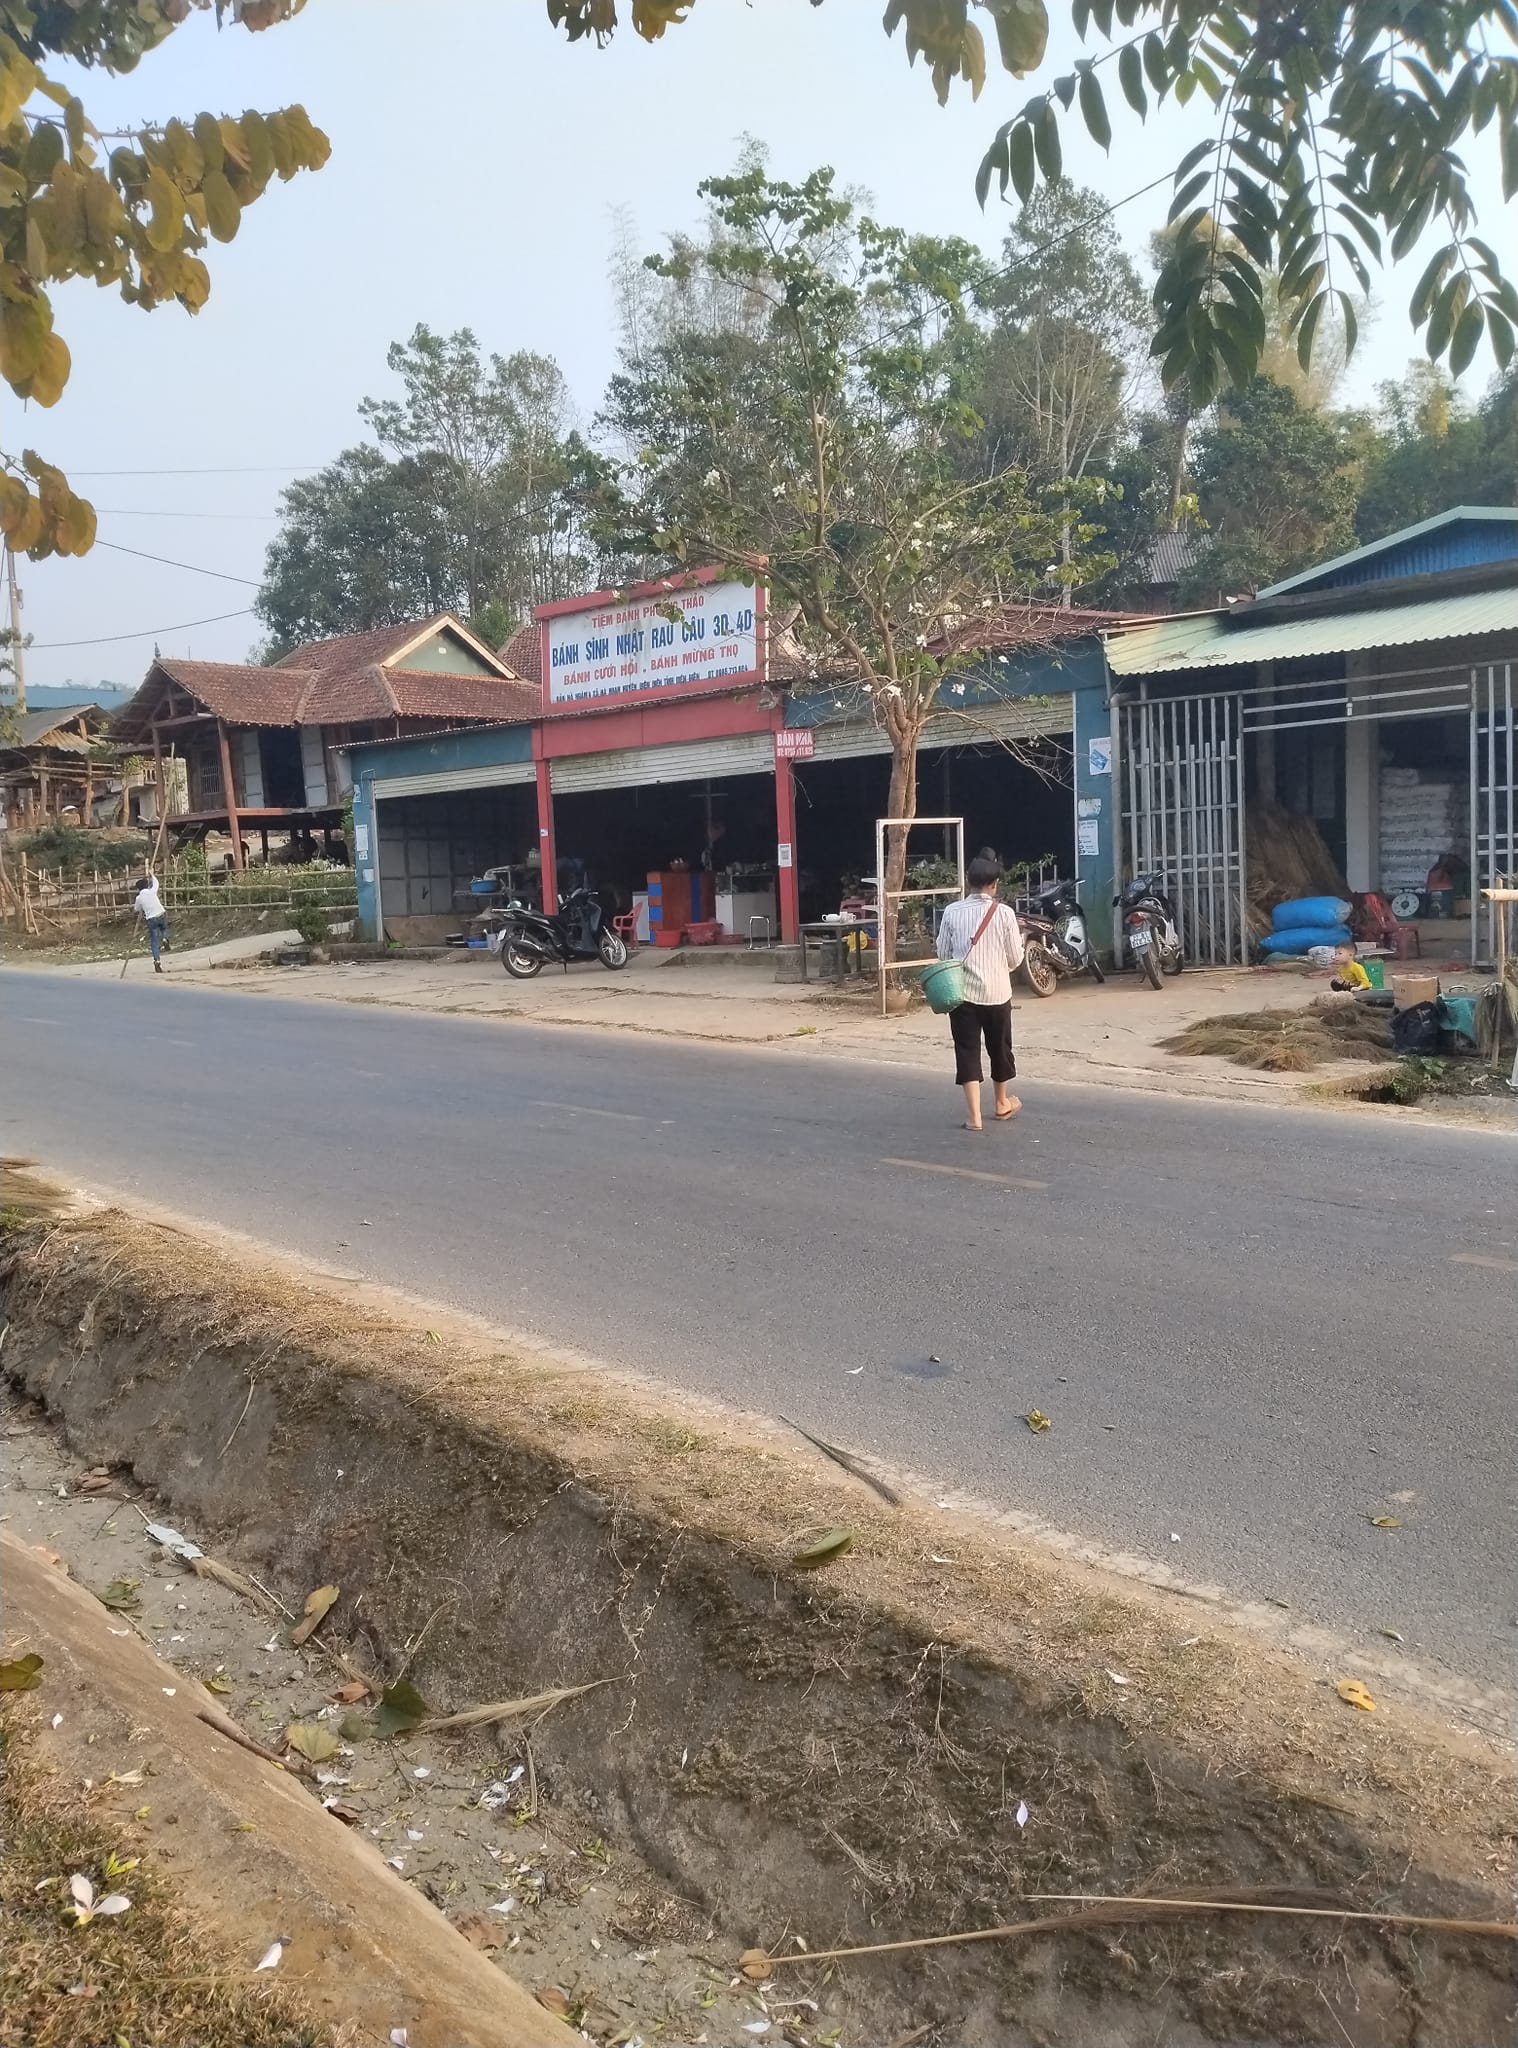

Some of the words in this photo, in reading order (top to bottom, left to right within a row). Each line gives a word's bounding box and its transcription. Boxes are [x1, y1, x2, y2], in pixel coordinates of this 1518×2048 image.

[592, 614, 613, 629] TIỆM
[617, 608, 640, 624] BÁNH
[681, 593, 704, 610] THẢO
[552, 642, 579, 667] BÁNH
[617, 629, 645, 656] NHẬT
[651, 624, 674, 649] RAU
[681, 616, 705, 643] CÂU
[563, 670, 591, 686] BÁNH
[594, 664, 616, 680] CƯỚI
[650, 654, 678, 671] BÁNH
[682, 648, 715, 665] MỪNG
[719, 643, 739, 658] THỌ
